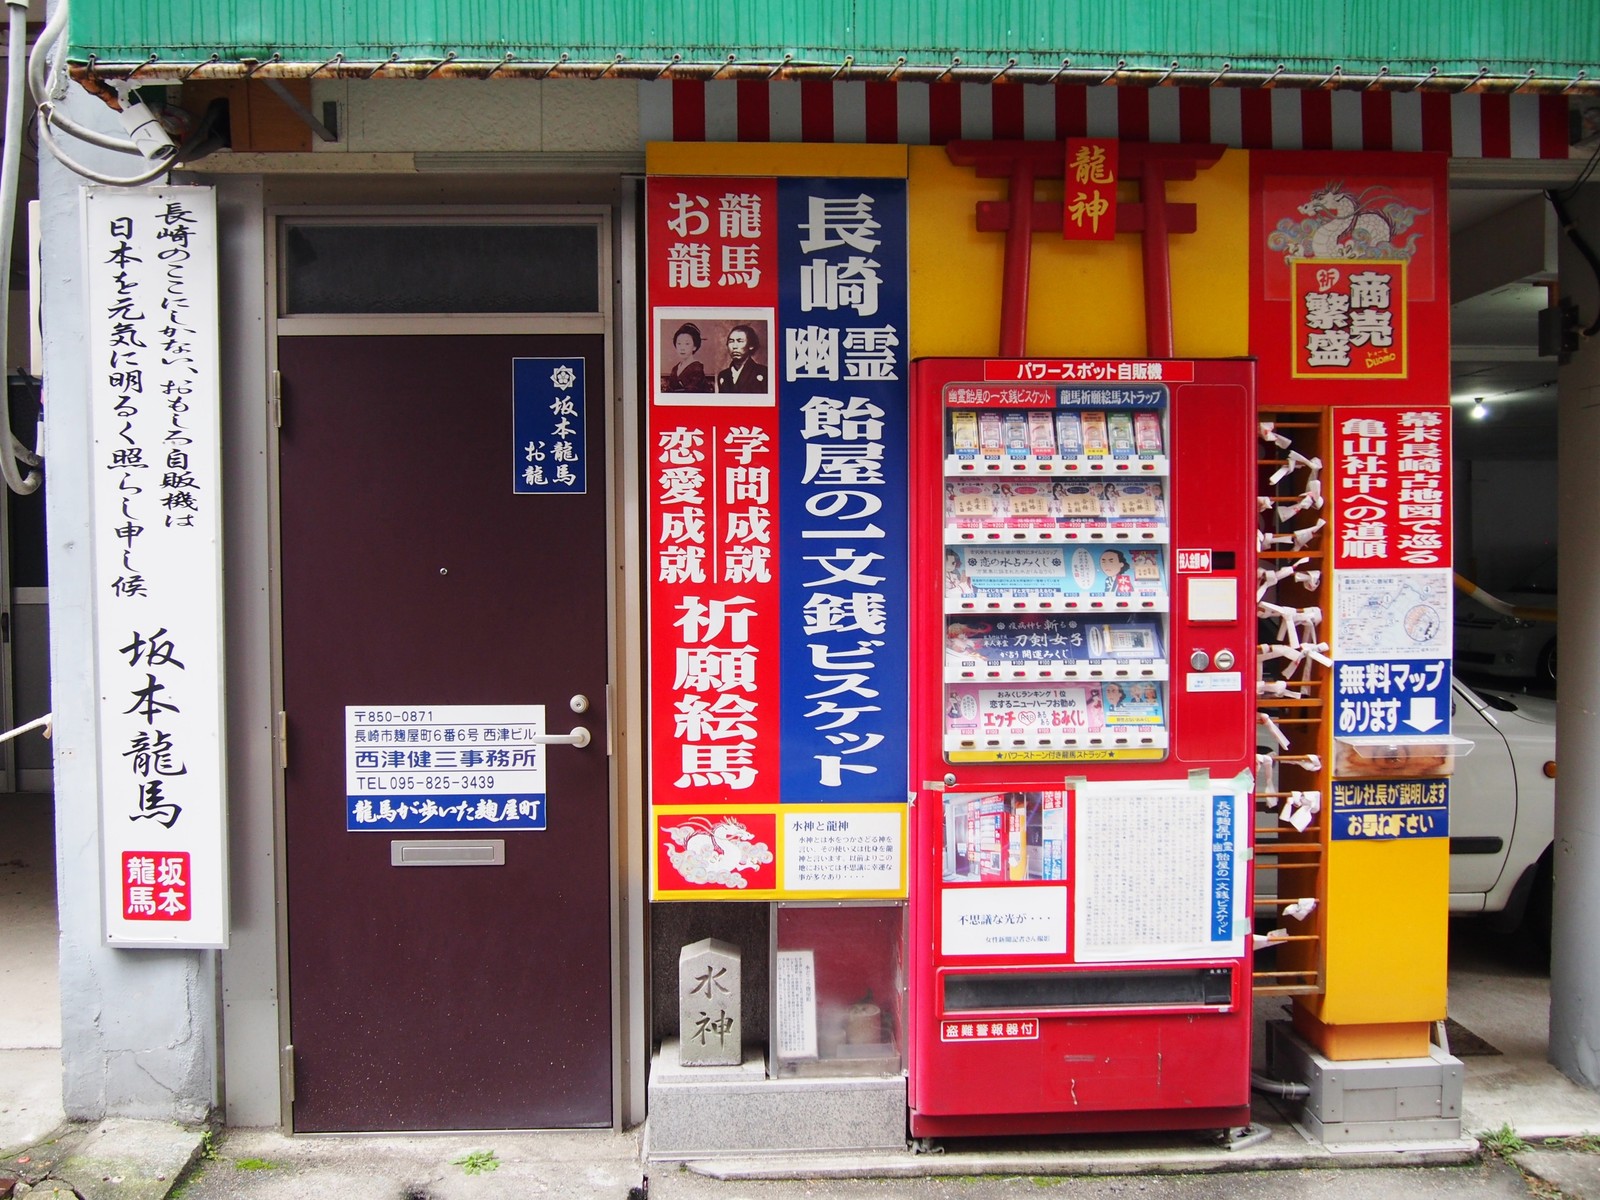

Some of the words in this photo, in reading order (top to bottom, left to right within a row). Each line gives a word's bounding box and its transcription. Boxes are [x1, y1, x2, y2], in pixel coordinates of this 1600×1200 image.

[1067, 144, 1114, 235] 龍神
[667, 192, 711, 289] お龍
[717, 193, 762, 289] 龍馬
[154, 202, 200, 528] 長崎のここにしかない、おもしろ自販機は
[1017, 362, 1163, 380] パワースポット自販機
[103, 217, 149, 598] 日本を元気に明るく照らし申し候
[1060, 390, 1162, 405] 龍馬祈願絵馬ストラップ
[521, 440, 549, 486] お龍
[549, 395, 579, 487] 坂本龍馬
[658, 426, 707, 585] 恋愛成就
[724, 425, 772, 585] 学問成就
[1340, 418, 1389, 559] 亀山社中への道順
[1397, 411, 1443, 564] 幕末長崎古地図で巡る
[980, 557, 1049, 568] 恋の水占みくじ
[1013, 633, 1083, 647] 刀剣女子
[672, 595, 760, 790] 祈願絵馬
[989, 699, 1076, 708] 恋するニューハーフお勧め
[1339, 661, 1445, 694] 無料マップ
[118, 627, 188, 829] 坂本龍馬
[483, 728, 537, 742] 西津ビル
[984, 711, 1016, 727] エッチ
[1052, 710, 1085, 726] おみくじ
[1339, 697, 1401, 733] あります
[355, 749, 537, 769] 西津健三事務所
[352, 798, 541, 824] 龍馬が歩いた麹屋町
[791, 820, 849, 832] 水神と龍神
[127, 856, 157, 916] 龍馬
[157, 856, 186, 917] 坂本
[689, 965, 735, 1049] 水神
[946, 1022, 1034, 1038] 盗難警報器付
